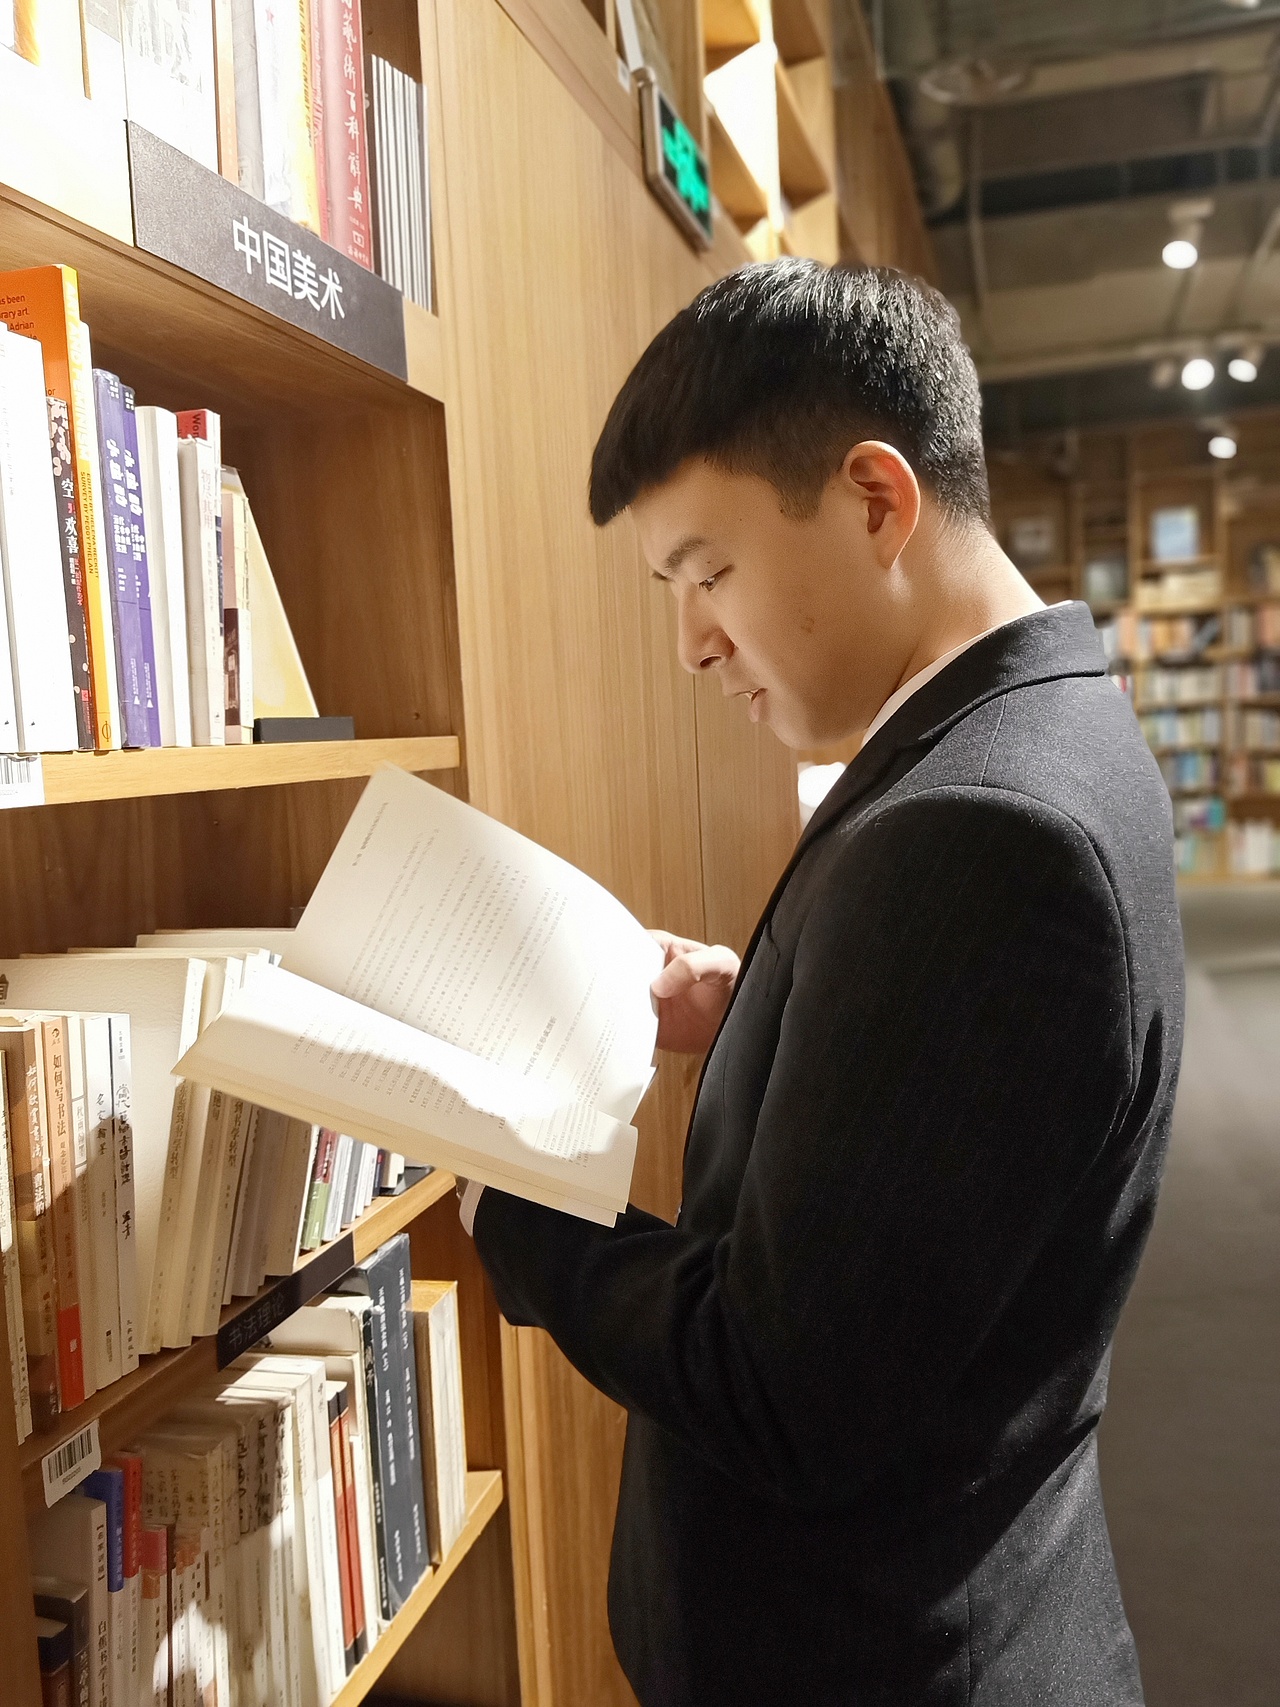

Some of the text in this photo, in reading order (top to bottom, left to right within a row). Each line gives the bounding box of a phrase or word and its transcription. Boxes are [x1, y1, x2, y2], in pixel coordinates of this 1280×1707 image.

[232, 216, 346, 320] 中国美术
[6, 294, 26, 304] been
[9, 321, 35, 331] Adrian
[46, 388, 56, 396] or
[87, 543, 95, 575] PHELAN
[53, 1054, 67, 1136] 如何写书法
[229, 1292, 286, 1350] 书法理论
